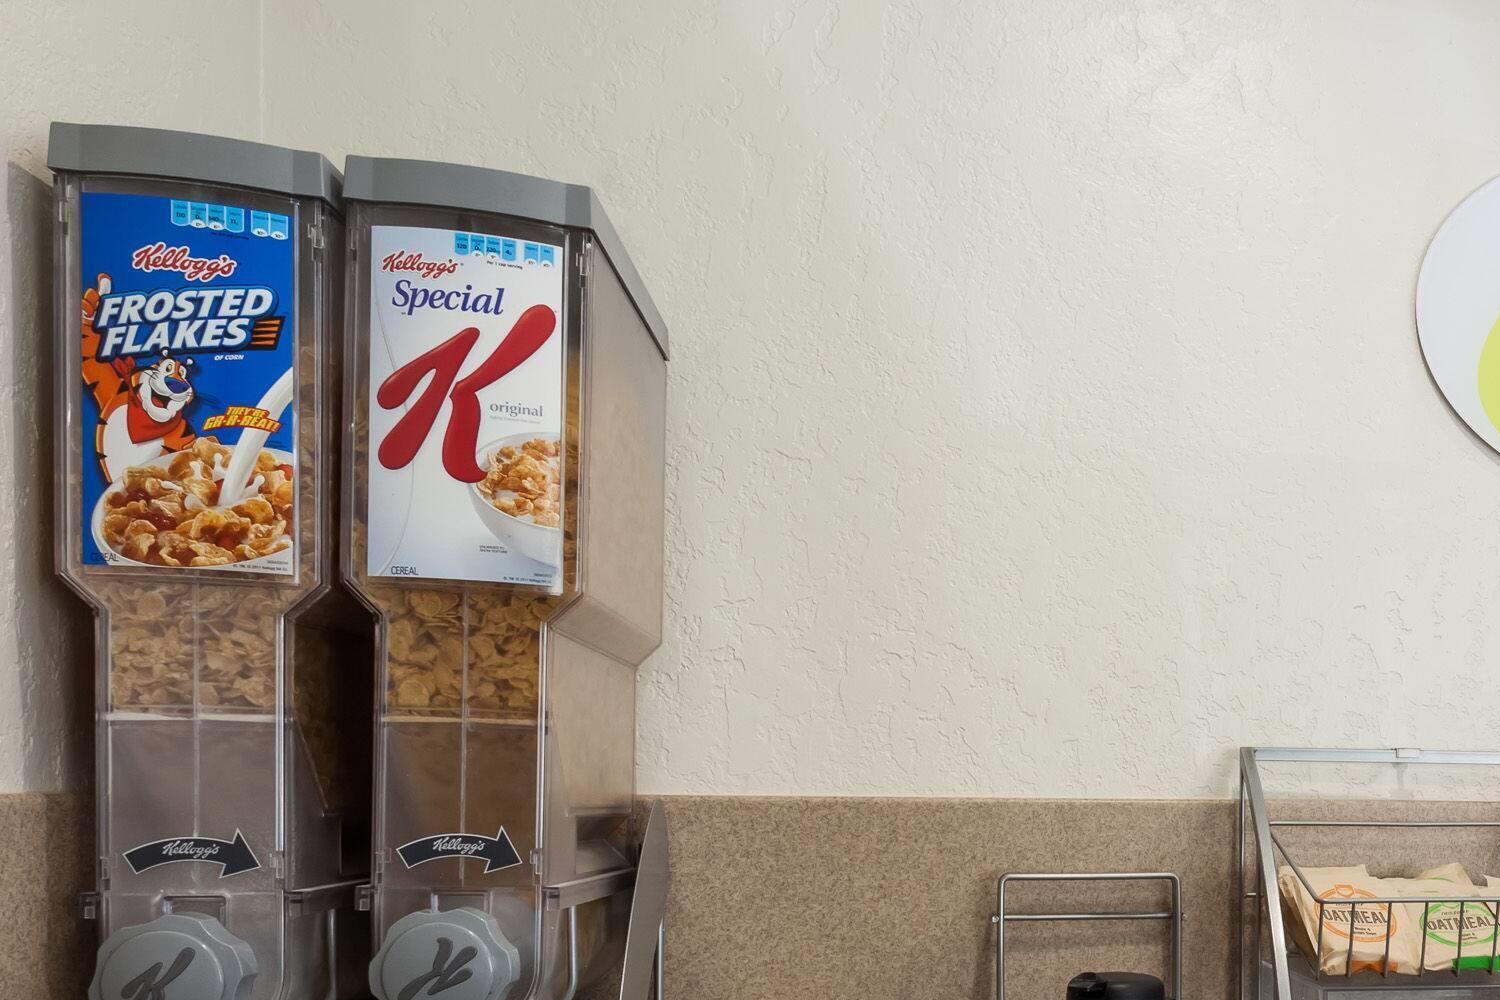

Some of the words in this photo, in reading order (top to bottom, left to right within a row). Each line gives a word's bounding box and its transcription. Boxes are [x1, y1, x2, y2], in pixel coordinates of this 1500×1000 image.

[131, 241, 237, 282] Kellogg's
[382, 250, 458, 279] Kellogg's
[97, 288, 273, 328] FROSTED
[392, 279, 505, 316] Special
[101, 317, 250, 357] FLAKES
[377, 304, 557, 483] K
[489, 401, 543, 417] original
[391, 566, 419, 576] CEREAL
[162, 840, 221, 859] Kellogg's
[432, 837, 486, 855] Kellogg's
[1323, 909, 1388, 924] OATMEAL
[1426, 915, 1496, 931] OATMEAL
